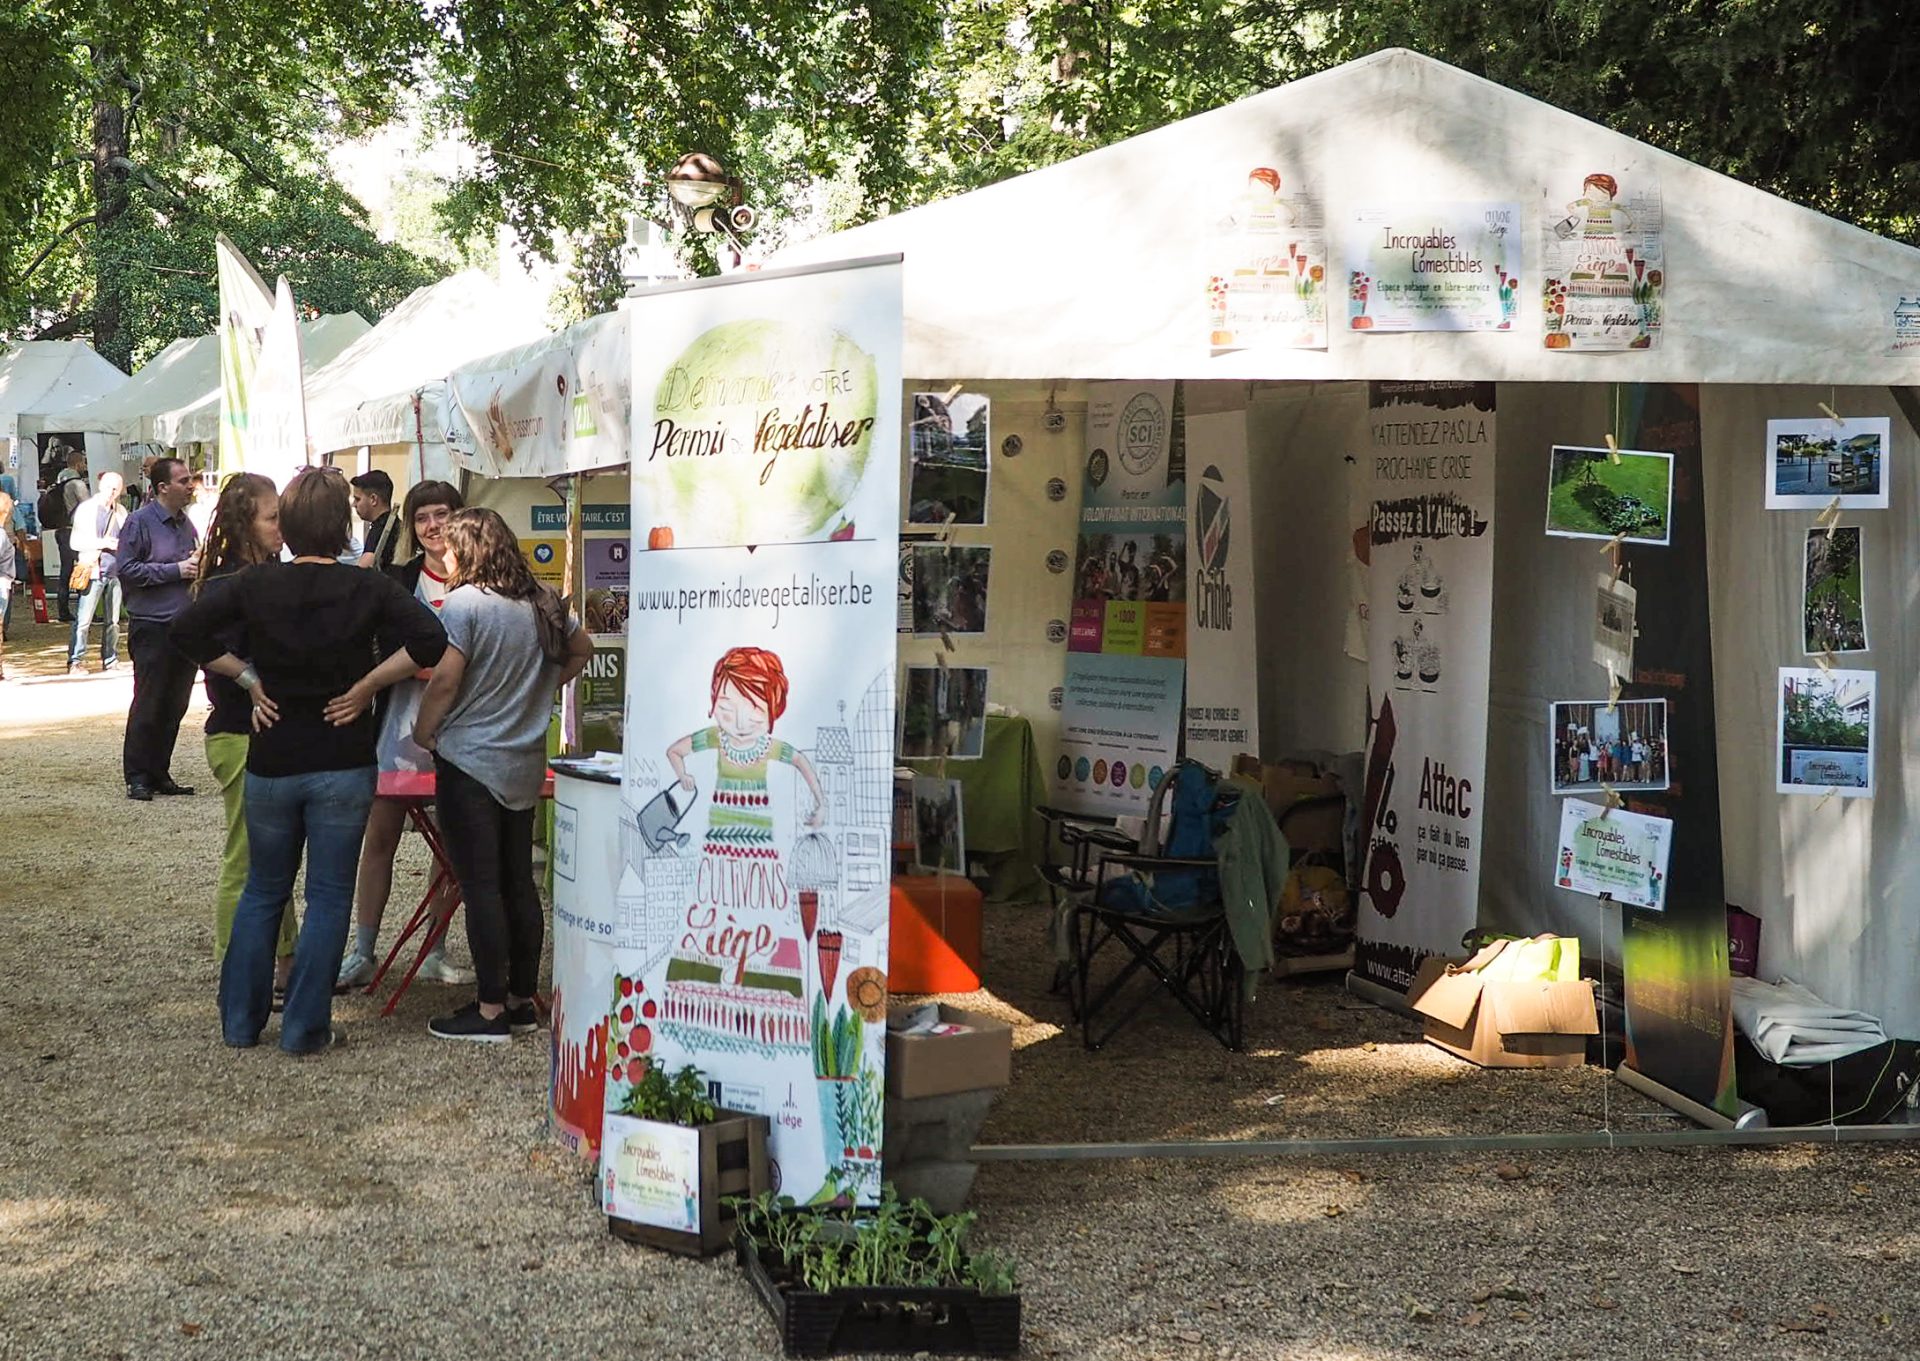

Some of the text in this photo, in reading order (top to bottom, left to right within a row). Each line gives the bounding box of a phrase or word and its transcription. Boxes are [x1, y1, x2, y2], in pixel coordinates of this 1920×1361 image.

[1383, 227, 1456, 258] Incroyables
[1412, 251, 1483, 274] Comestibles
[1445, 281, 1490, 292] libre-service
[648, 419, 729, 462] Permis
[753, 402, 875, 486] Végétaliser
[1376, 455, 1472, 480] PROCHAINE CRISE
[537, 511, 626, 524] ÊTRE VOTAIRE, C'EST
[1372, 503, 1476, 535] Passez à l'Attac !
[638, 570, 873, 629] www.permisdevegetaliser.be
[1196, 568, 1232, 631] Crible
[1418, 756, 1472, 819] Attac
[1418, 824, 1470, 850] ça fait du lien
[1581, 820, 1625, 846] Incroyables
[1417, 846, 1469, 872] par où ça passe.
[1596, 841, 1642, 865] Comestibles
[697, 857, 789, 912] CULTIVONS
[584, 914, 596, 932] de
[681, 903, 777, 985] Liège
[777, 1111, 803, 1130] Liège
[622, 1137, 662, 1162] Incroyables
[635, 1158, 676, 1183] Comestibles
